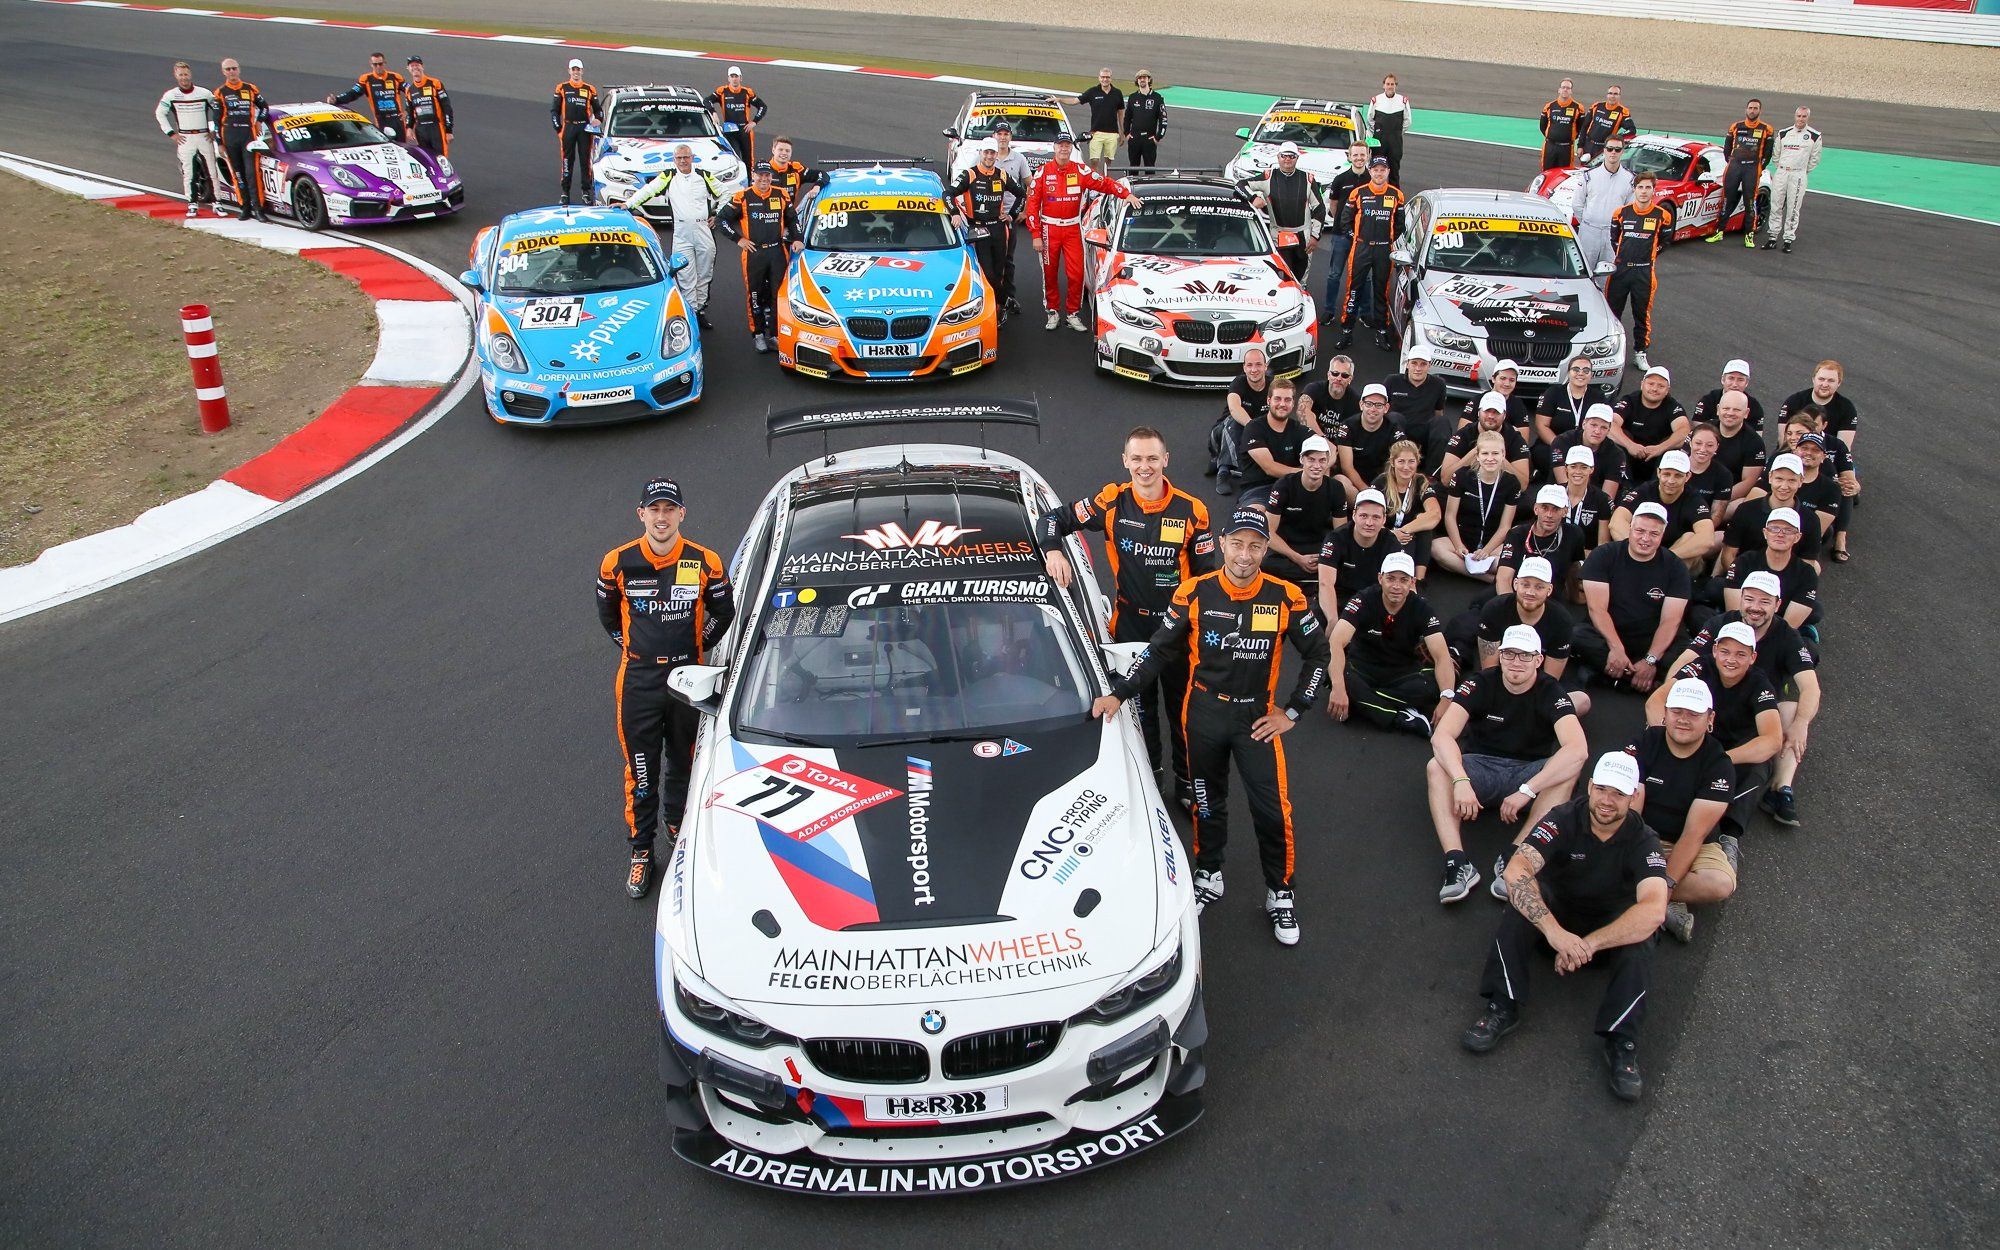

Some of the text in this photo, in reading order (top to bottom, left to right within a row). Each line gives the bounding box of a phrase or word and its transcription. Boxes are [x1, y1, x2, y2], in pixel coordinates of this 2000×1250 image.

[332, 113, 361, 121] ADAC
[980, 108, 1009, 116] ADAC
[1027, 108, 1055, 117] ADAC
[1272, 115, 1301, 123] ADAC
[285, 116, 315, 128] ADAC
[1263, 122, 1286, 133] 302
[1318, 117, 1347, 127] ADAC
[282, 127, 312, 143] 305
[341, 152, 372, 161] 305
[830, 190, 933, 198] ADRENALIN-RENNTAXI.de
[829, 200, 869, 212] ADAC
[896, 199, 937, 211] ADAC
[1189, 205, 1215, 213] GRAN
[1216, 206, 1255, 217] TURISMO
[1683, 200, 1697, 217] 131
[817, 212, 849, 231] 303
[1440, 211, 1564, 223] ADRENALIN-RENNTAXI.de
[513, 225, 629, 241] ADRENALIN-MOTORSPORT
[1447, 220, 1490, 231] ADAC
[1518, 221, 1560, 234] ADAC
[516, 235, 560, 253] ADAC
[589, 232, 632, 244] ADAC
[1433, 232, 1465, 250] 300
[498, 253, 529, 276] 304
[824, 259, 866, 273] 303
[868, 286, 934, 302] pixum
[1444, 282, 1488, 298] 300
[1145, 294, 1278, 308] MAINHATTANWHEELS
[531, 305, 573, 323] 304
[588, 299, 651, 346] pixum
[1484, 316, 1569, 328] MAINHATTANWHEELS
[868, 344, 894, 356] H&R
[1195, 348, 1219, 359] H&R
[536, 362, 656, 382] ADRENALIN MOTORSPORT
[803, 411, 861, 421] BECOME
[863, 409, 900, 417] PART
[654, 481, 678, 491] pixum
[1162, 519, 1186, 529] ADAC
[1241, 510, 1266, 523] pixum
[785, 541, 1033, 565] MAINHATTANWHEELS
[1134, 542, 1176, 556] pixum
[679, 561, 699, 569] ADAC
[781, 551, 1038, 575] FELGENOBERFLÄCHENTECHNIK
[1145, 558, 1175, 566] pixum.de
[901, 581, 953, 599] GRAN
[955, 577, 1049, 598] TURISMO
[649, 600, 692, 614] pixum
[920, 597, 943, 605] REAL
[944, 595, 978, 604] DRIVING
[979, 594, 1048, 604] SIMULATOR
[661, 611, 691, 623] pixum.de
[1253, 605, 1279, 616] ADAC
[702, 617, 719, 640] pixum
[1232, 651, 1268, 661] pixum.de
[1125, 655, 1144, 681] pixum
[1304, 667, 1323, 697] pixum
[980, 745, 993, 754] E
[634, 752, 648, 789] pixum
[806, 767, 860, 794] TOTAL
[736, 774, 815, 819] 77
[1195, 778, 1206, 815] pixum
[797, 788, 894, 840] ADAC NORDRHEIN
[1060, 788, 1096, 825] PROTO
[1070, 793, 1109, 830] TYPING
[1084, 802, 1126, 843] SCHWAHN
[906, 792, 936, 906] Motorsport
[1020, 825, 1075, 881] CNC
[1155, 807, 1178, 886] FALKEN
[672, 837, 687, 917] FALKEN
[773, 927, 1084, 981] MAINHATTANWHEELS
[768, 951, 1092, 990] FELGENOBERFLÄCHENTECHNIK
[886, 1095, 951, 1117] H&R
[710, 1114, 1166, 1193] ADRENALIN-MOTORSPORT
